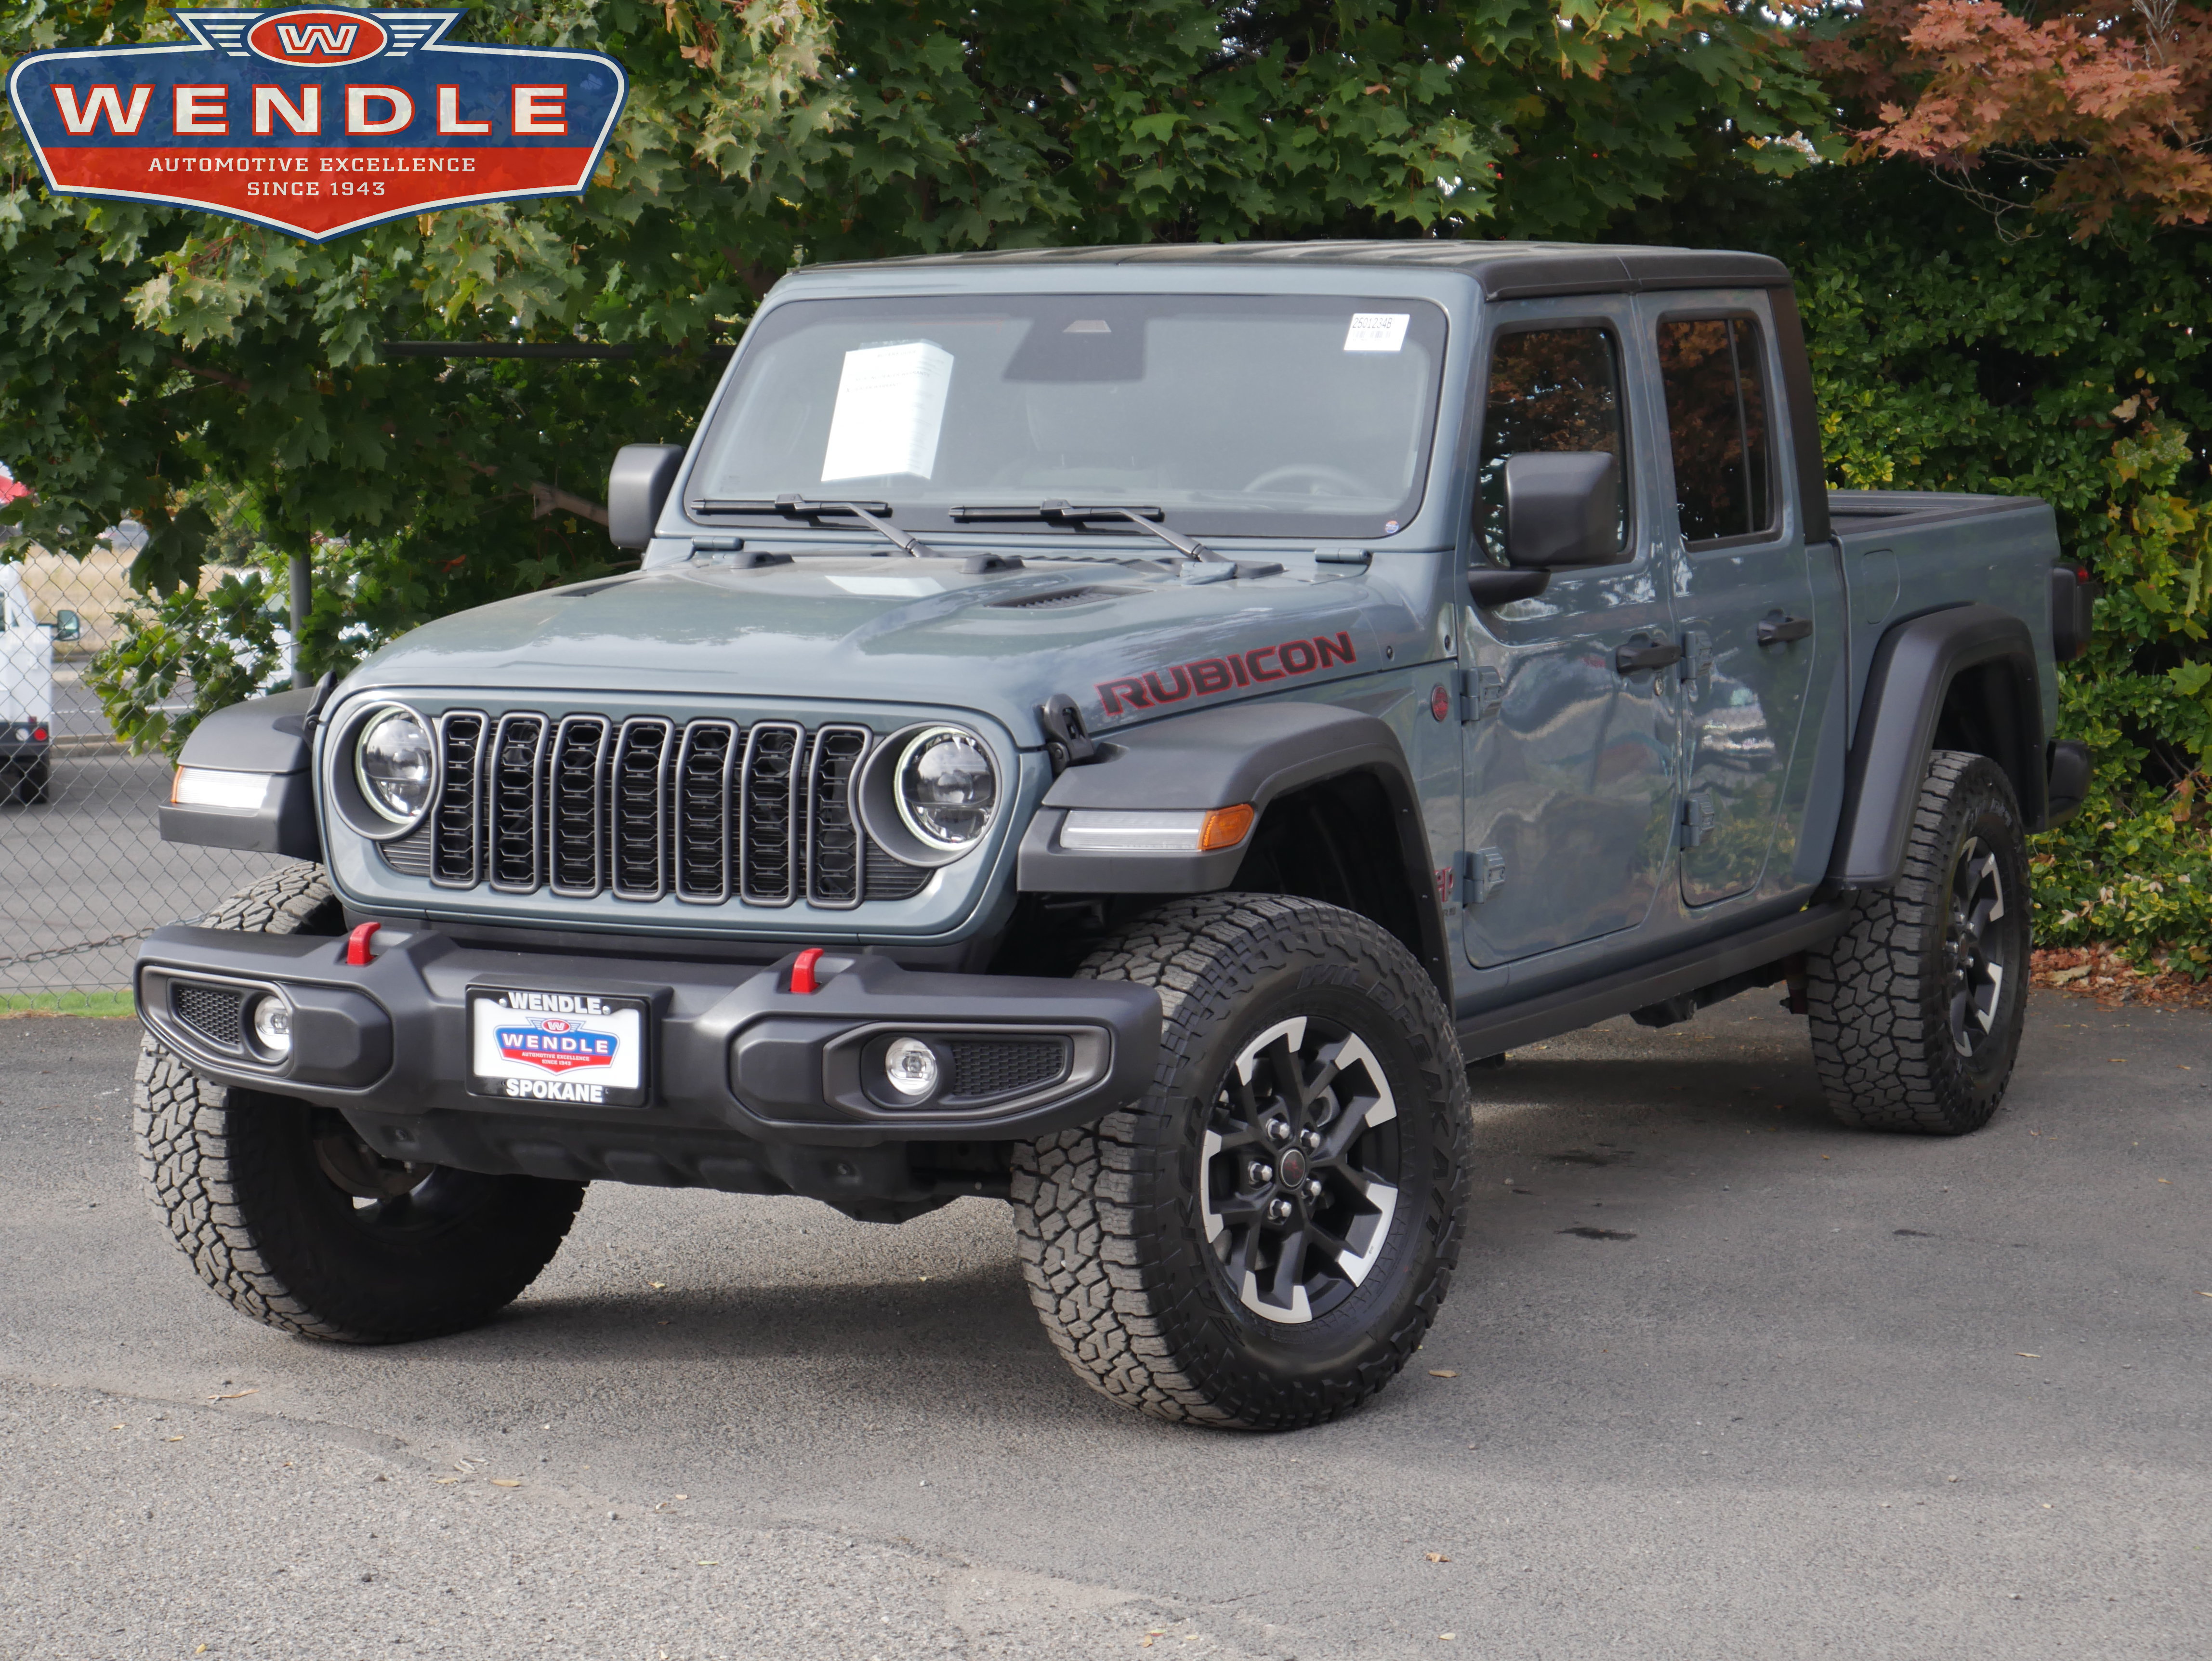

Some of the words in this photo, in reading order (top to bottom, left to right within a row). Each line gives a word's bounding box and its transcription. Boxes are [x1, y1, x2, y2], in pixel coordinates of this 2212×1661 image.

[1353, 317, 1393, 329] 2501234B
[1094, 631, 1356, 716] RUBICON
[508, 992, 602, 1015] WENDLE
[501, 1033, 608, 1054] WENDLE
[522, 1051, 556, 1059] AUTOMOTIVE
[506, 1079, 603, 1103] SPOKANE
